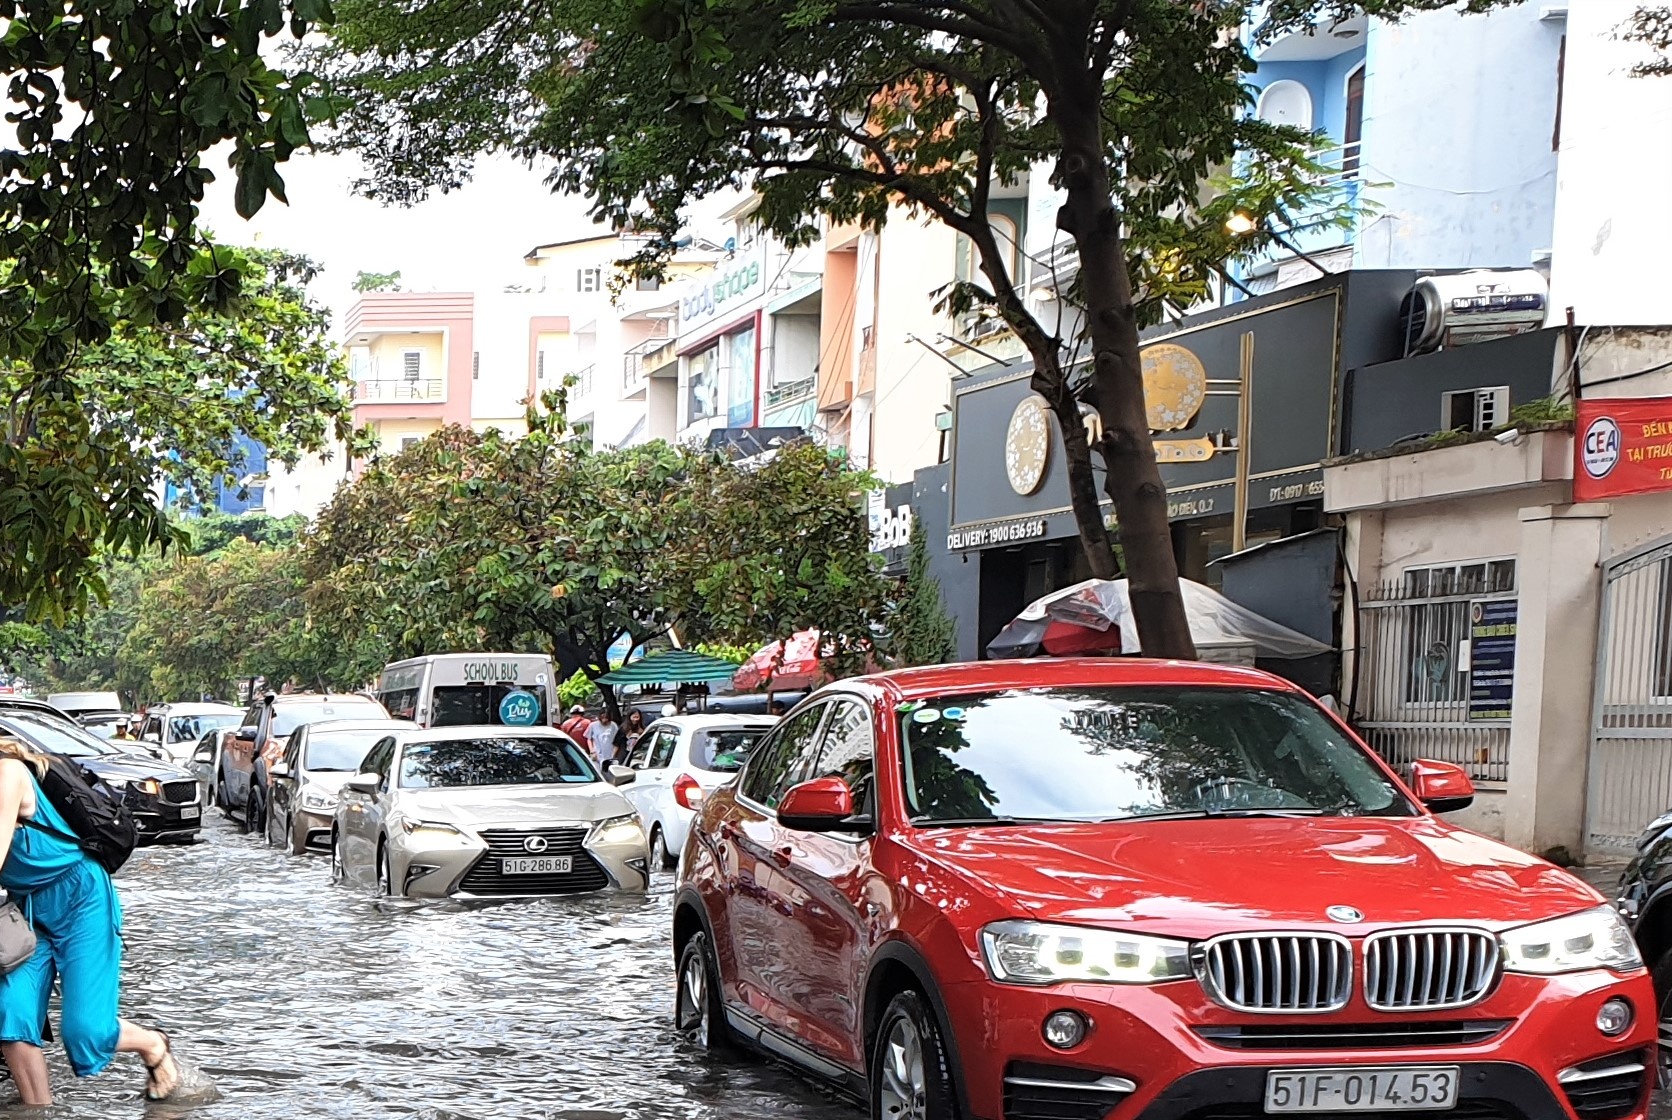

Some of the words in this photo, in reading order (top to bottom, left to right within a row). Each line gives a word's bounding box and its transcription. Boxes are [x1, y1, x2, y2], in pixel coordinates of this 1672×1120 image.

[1585, 430, 1618, 454] CEA
[947, 531, 989, 550] DELIVERY:
[989, 527, 1009, 543] 1900
[1009, 523, 1026, 540] 636
[1025, 519, 1044, 537] 936
[463, 662, 499, 681] SCHOOL
[500, 662, 519, 681] BUS
[1272, 1072, 1450, 1107] 51F-014.53
